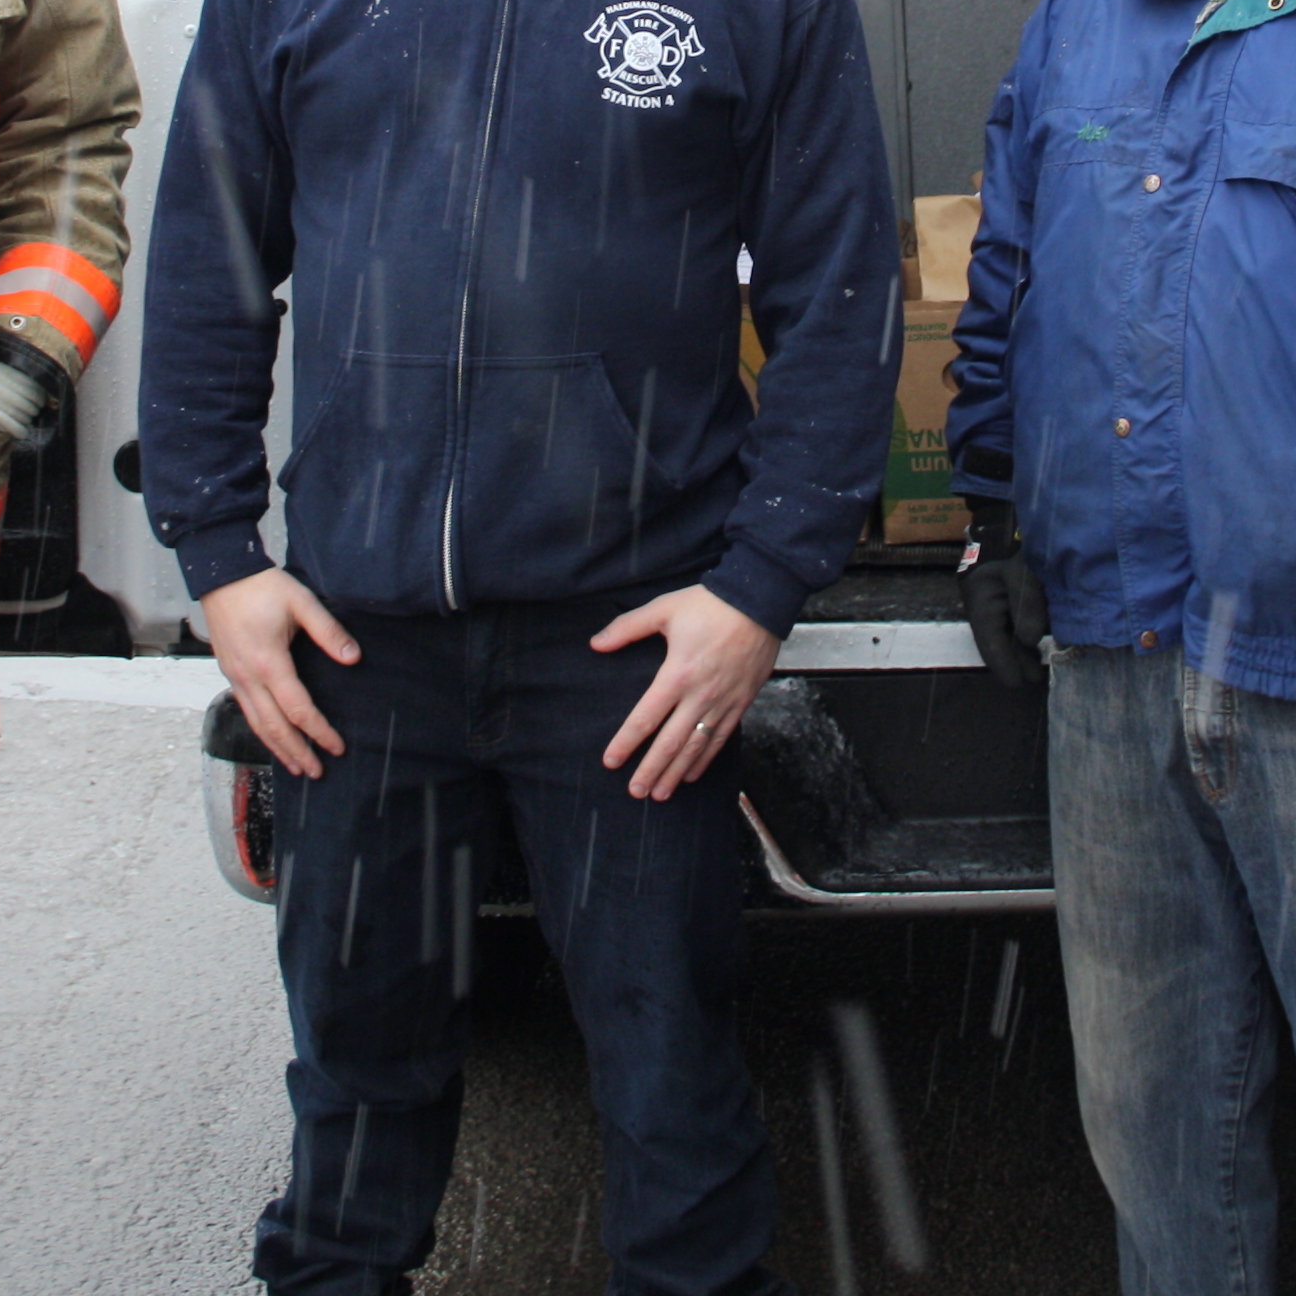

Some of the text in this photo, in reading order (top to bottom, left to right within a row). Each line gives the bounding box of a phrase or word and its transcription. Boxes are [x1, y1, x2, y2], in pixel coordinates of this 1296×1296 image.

[606, 0, 695, 25] HALDIMAND COUNTY
[633, 18, 660, 30] FIRE
[609, 38, 680, 66] F D
[618, 71, 661, 85] RESCUE
[601, 87, 675, 108] STATION 4
[911, 456, 952, 473] um
